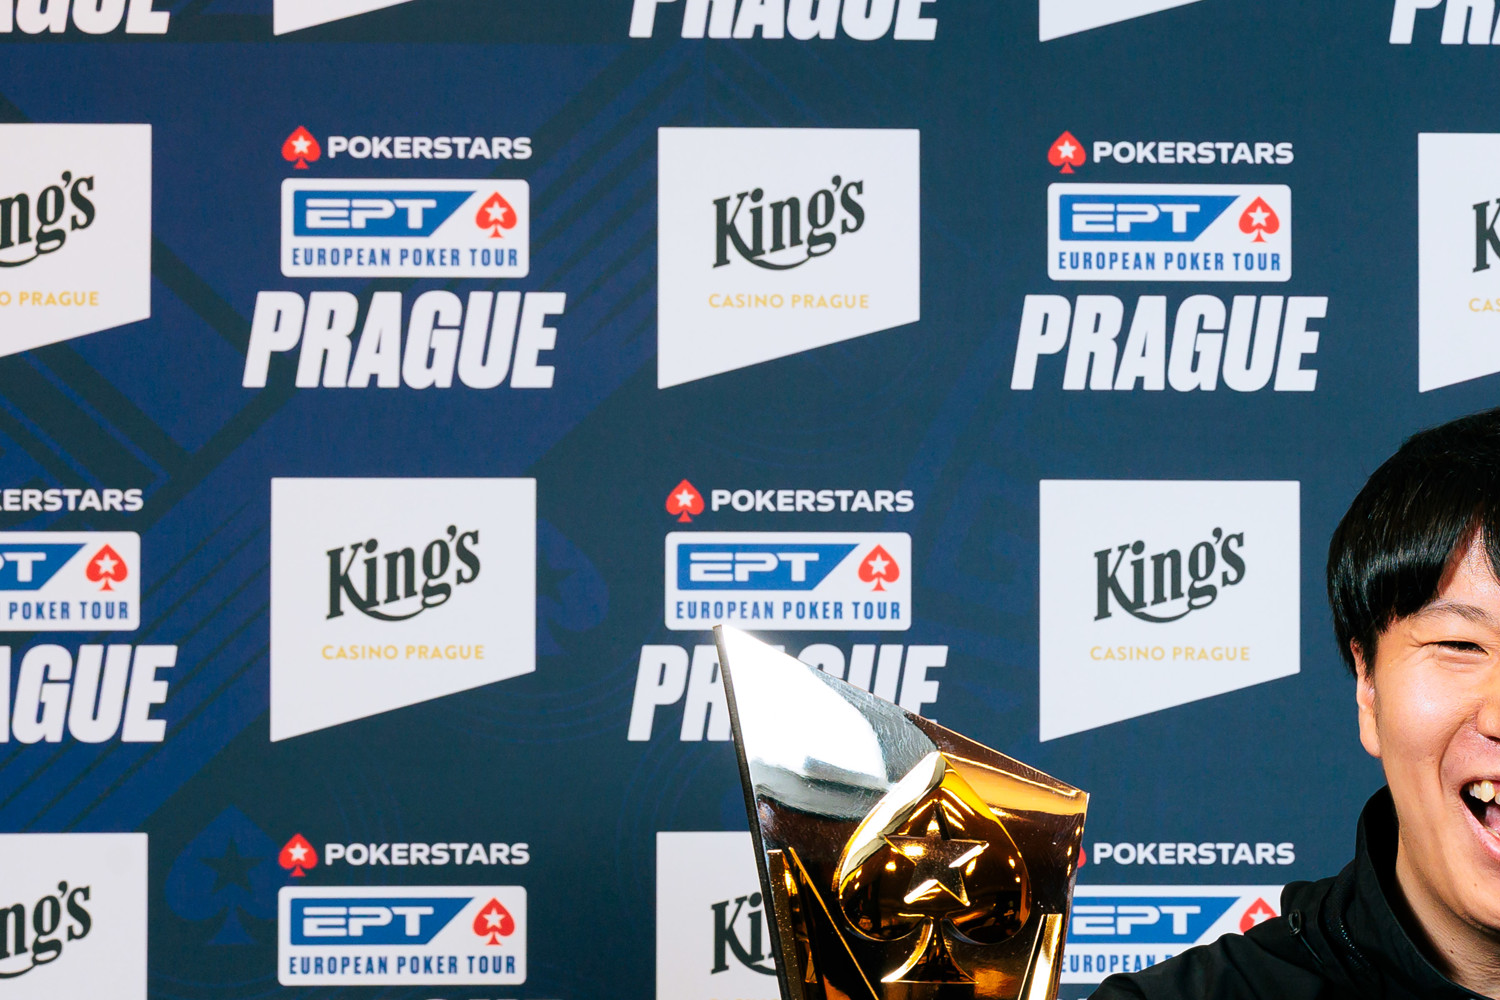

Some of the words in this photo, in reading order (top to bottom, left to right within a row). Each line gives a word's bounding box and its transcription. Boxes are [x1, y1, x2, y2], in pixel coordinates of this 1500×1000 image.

[328, 136, 532, 159] POKERSTARS
[1094, 142, 1293, 164] POKERSTARS
[306, 199, 436, 228] EPT
[713, 176, 864, 270] King's
[1073, 204, 1200, 232] EPT
[293, 248, 390, 265] EUROPEAN
[400, 249, 459, 266] POKER
[470, 249, 517, 266] TOUR
[1059, 252, 1155, 270] EUROPEAN
[1165, 252, 1223, 270] POKER
[1233, 253, 1280, 271] TOUR
[19, 291, 98, 306] PRAGUE
[709, 293, 784, 308] CASINO
[792, 294, 868, 309] PRAGUE
[243, 291, 566, 389] PRAGUE
[1011, 295, 1328, 391] PRAGUE
[0, 488, 144, 512] ERSTARS
[712, 490, 914, 512] POKERSTARS
[327, 525, 480, 621] King's
[690, 553, 819, 581] EPT
[1095, 528, 1245, 623] King's
[9, 601, 70, 620] POKER
[80, 601, 129, 620] TOUR
[677, 601, 773, 619] EUROPEAN
[783, 602, 842, 619] POKER
[852, 602, 900, 619] TOUR
[322, 645, 398, 660] CASINO
[406, 645, 484, 660] PRAGUE
[1090, 646, 1165, 661] CASINO
[1173, 646, 1249, 661] PRAGUE
[0, 644, 178, 744] GUE
[326, 843, 529, 865] POKERSTARS
[1093, 843, 1296, 865] POKERSTARS
[304, 907, 433, 936] EPT
[1072, 905, 1202, 935] EPT
[289, 956, 387, 975] EUROPEAN
[397, 956, 457, 974] POKER
[467, 956, 515, 974] TOUR
